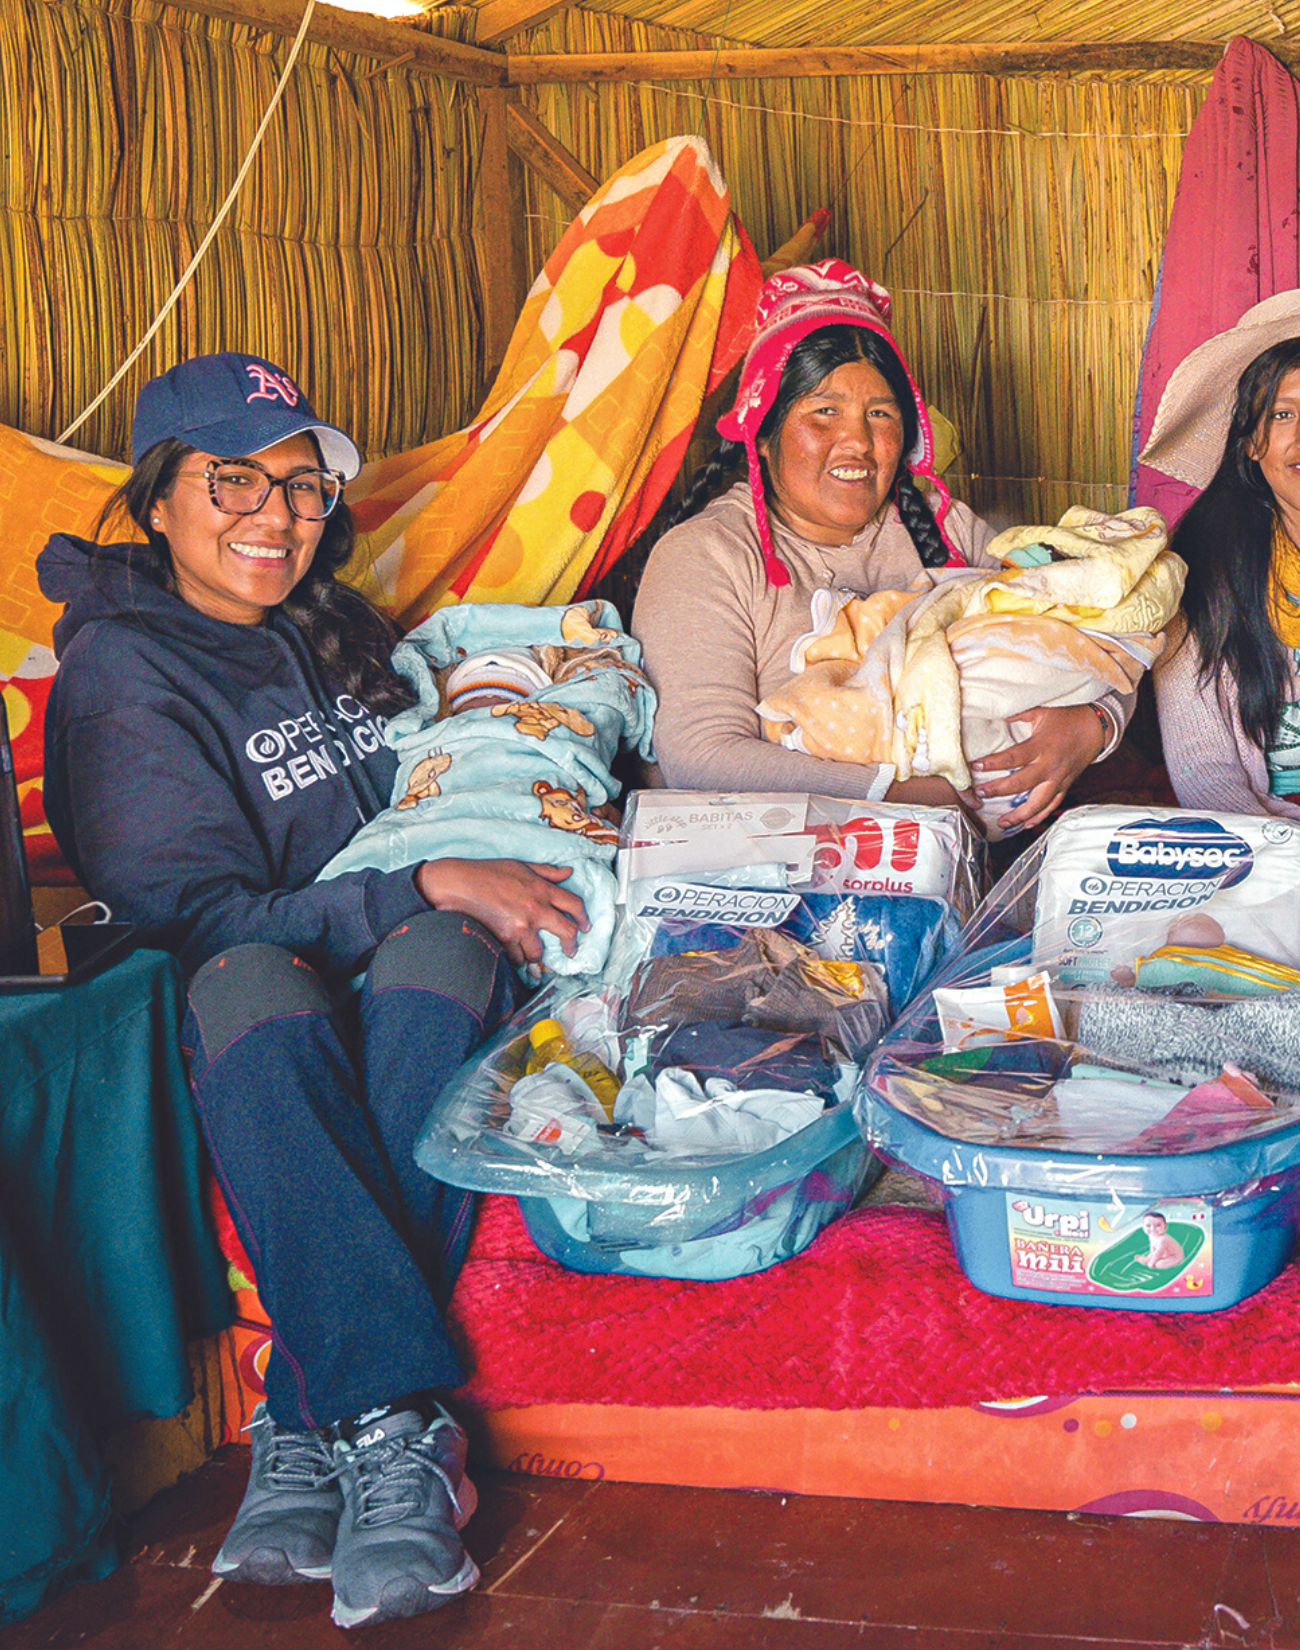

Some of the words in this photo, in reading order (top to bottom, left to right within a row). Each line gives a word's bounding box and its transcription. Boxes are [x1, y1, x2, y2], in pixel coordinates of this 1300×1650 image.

[689, 811, 753, 823] BABITAS
[1118, 839, 1242, 870] Babysec
[1078, 924, 1095, 938] 12
[1021, 1204, 1090, 1238] Urpi
[1015, 1238, 1083, 1256] BAÑERA
[1017, 1250, 1085, 1274] mili
[356, 1428, 386, 1449] FILA
